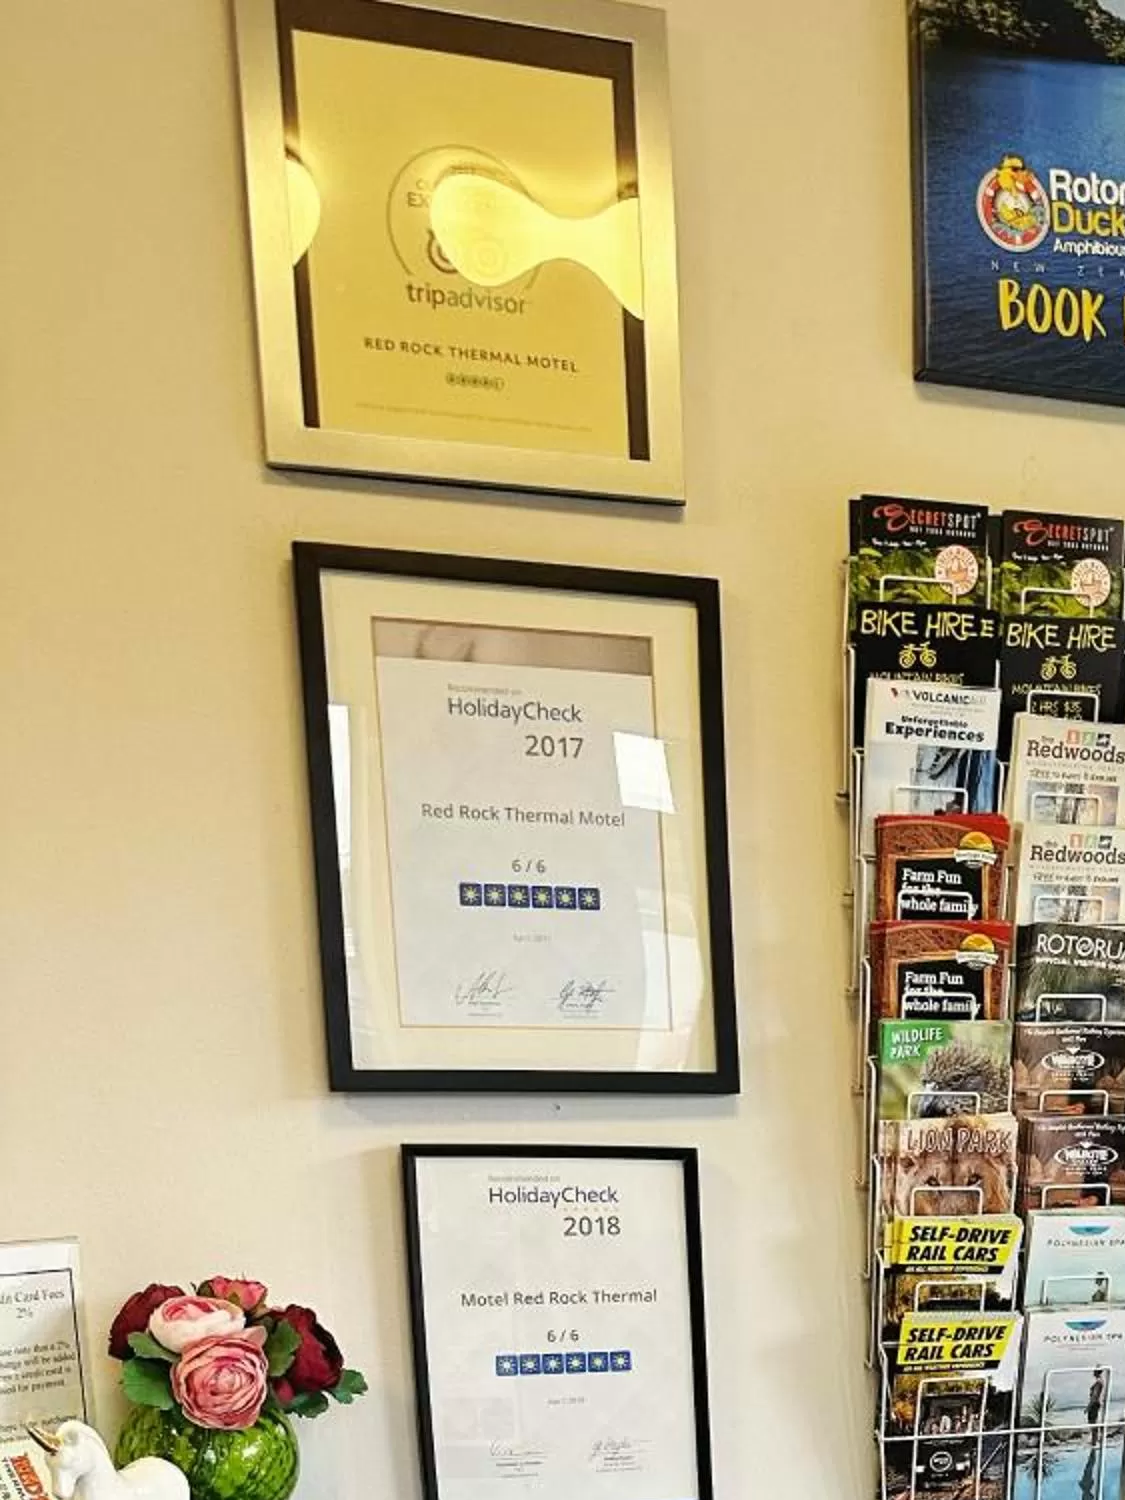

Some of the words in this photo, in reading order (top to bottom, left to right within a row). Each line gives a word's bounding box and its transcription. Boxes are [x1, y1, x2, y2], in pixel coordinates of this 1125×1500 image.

[991, 258, 1047, 274] NEW
[406, 280, 531, 316] tripadvisor
[998, 278, 1108, 343] BOOK
[364, 336, 395, 353] RED
[400, 340, 443, 358] ROCK
[449, 345, 522, 367] THERMAL
[527, 353, 580, 374] MOTEL
[860, 609, 919, 638] BIKE
[925, 611, 979, 642] HIRE
[1006, 620, 1062, 650] BIKE
[1066, 622, 1118, 653] HIRE
[447, 697, 583, 726] HolidayCheck
[902, 714, 968, 728] Unforgettable
[885, 722, 985, 743] Experiences
[524, 734, 584, 759] 2017
[1026, 739, 1125, 764] Redwoods
[421, 803, 454, 819] Red
[459, 805, 500, 822] Rock
[504, 807, 575, 826] Thermal
[578, 811, 626, 829] Motel
[511, 859, 522, 873] 6
[536, 860, 547, 874] 6
[902, 867, 936, 884] Farm
[937, 870, 962, 885] Fun
[901, 898, 938, 913] whole
[904, 971, 938, 985] Farm
[939, 973, 964, 985] Fun
[904, 1000, 939, 1013] whole
[891, 1027, 944, 1044] WILDLIFE
[891, 1043, 921, 1059] PARK
[907, 1127, 954, 1152] LION
[957, 1127, 1013, 1152] PARK
[488, 1186, 619, 1209] HolidayCheck
[563, 1215, 622, 1238] 2018
[909, 1225, 1012, 1244] SELF-DRIVE
[907, 1244, 948, 1262] RAIL
[952, 1245, 1000, 1262] CARS
[461, 1292, 510, 1308] Motel
[513, 1291, 545, 1306] Red
[549, 1289, 588, 1305] Rock
[592, 1288, 658, 1304] Thermal
[546, 1330, 557, 1344] 6
[569, 1328, 580, 1343] 6
[907, 1324, 1009, 1343] SELF-DRIVE
[904, 1345, 945, 1362] RAIL
[948, 1343, 996, 1359] CARS
